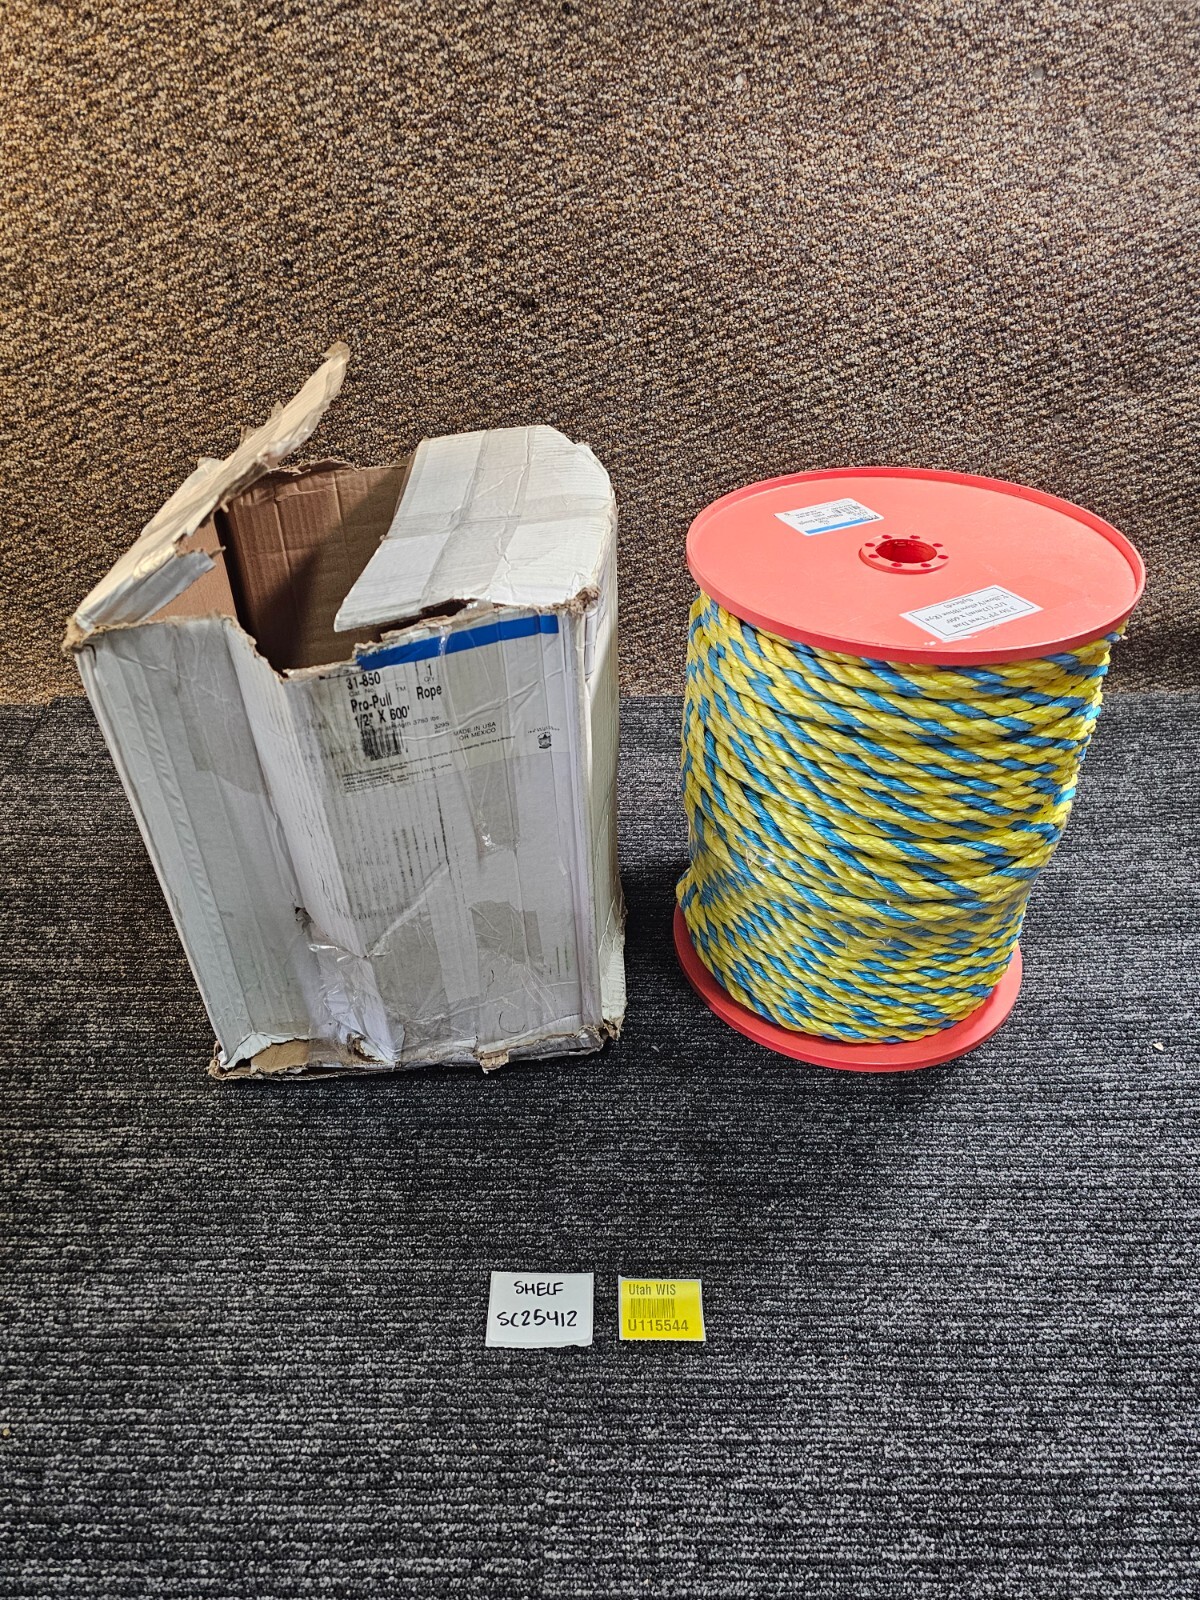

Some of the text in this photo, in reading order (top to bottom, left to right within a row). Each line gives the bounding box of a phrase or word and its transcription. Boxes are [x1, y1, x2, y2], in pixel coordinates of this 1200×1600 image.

[345, 671, 381, 691] 31-850
[350, 692, 393, 714] Pro-Pull
[416, 685, 443, 701] Rope
[355, 705, 410, 729] 1/2" X 600'
[453, 727, 472, 737] MADE
[482, 721, 497, 729] USA
[471, 727, 497, 739] MEXICO
[513, 1280, 564, 1297] SHELF
[628, 1283, 677, 1296] Utah WIS
[496, 1308, 578, 1328] SC25412
[627, 1318, 689, 1332] U115544
